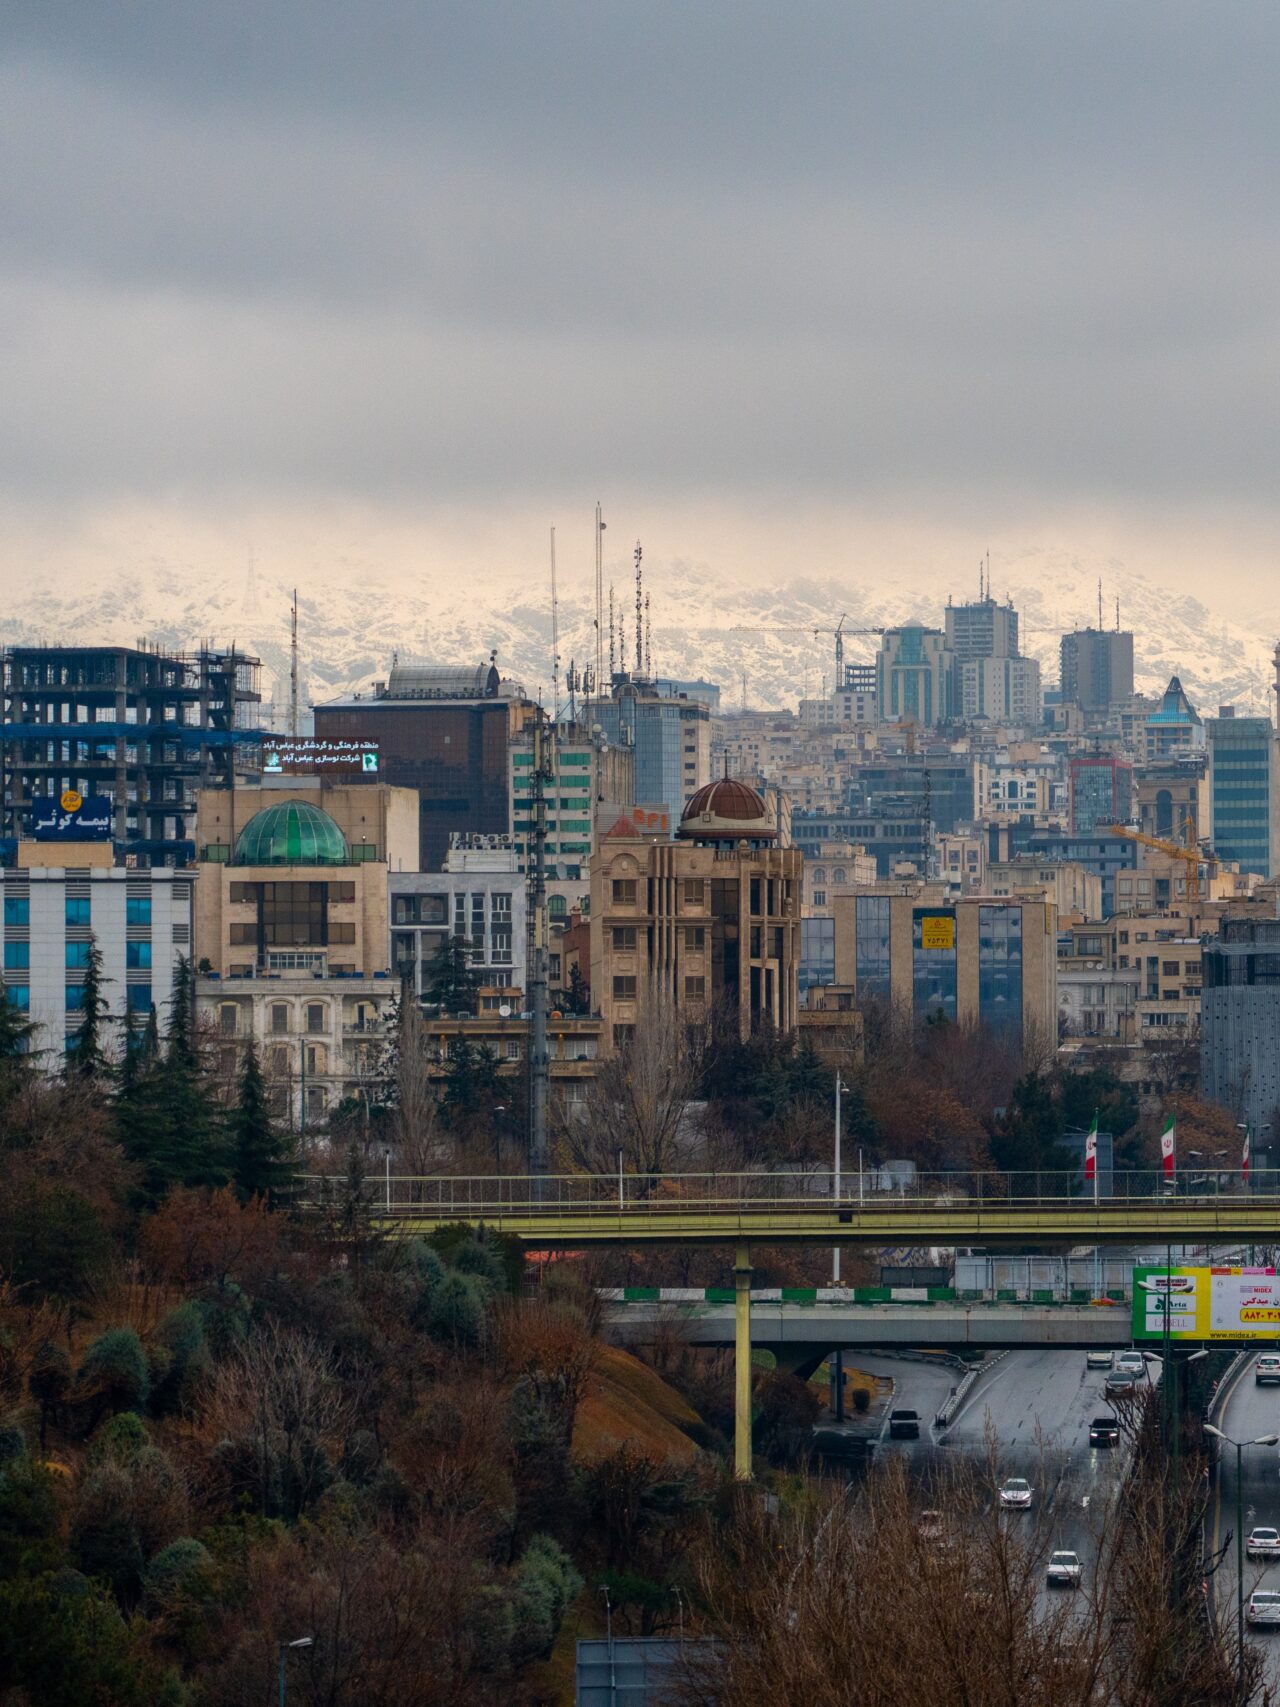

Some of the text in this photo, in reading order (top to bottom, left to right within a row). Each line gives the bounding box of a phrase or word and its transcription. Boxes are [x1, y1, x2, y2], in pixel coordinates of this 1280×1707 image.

[263, 740, 276, 751] آباد
[276, 742, 295, 750] عباس
[295, 740, 327, 751] گردشگری
[333, 741, 359, 750] فرهنگی
[360, 741, 379, 749] منطقه
[281, 752, 361, 764] شرکت نوسازی عباس آباد
[35, 809, 109, 831] بیمه کوثر
